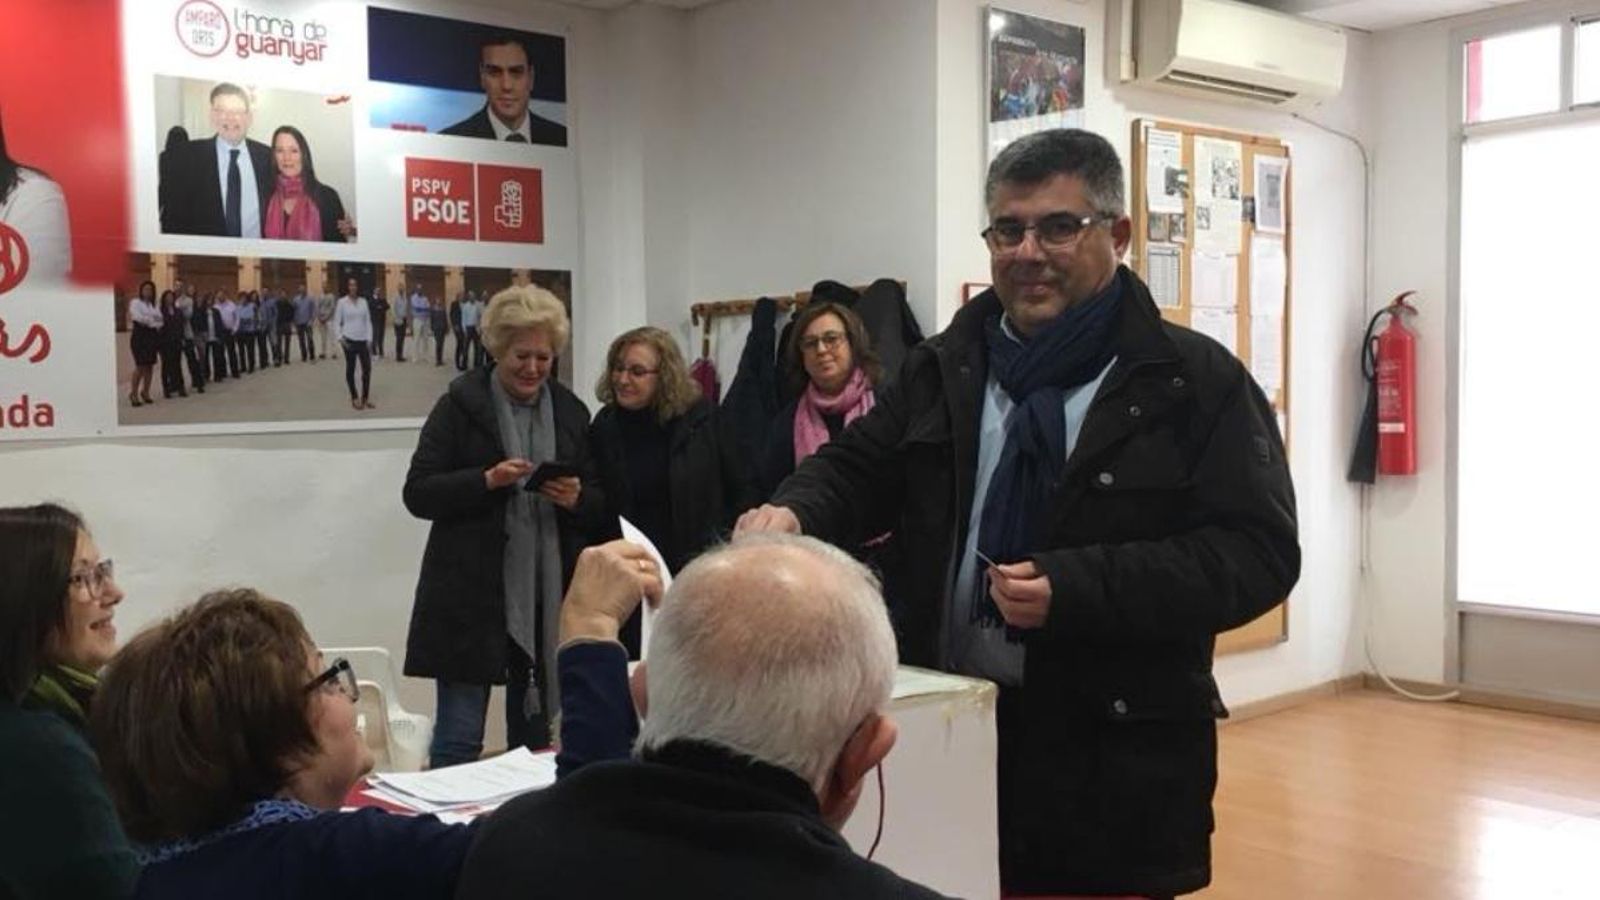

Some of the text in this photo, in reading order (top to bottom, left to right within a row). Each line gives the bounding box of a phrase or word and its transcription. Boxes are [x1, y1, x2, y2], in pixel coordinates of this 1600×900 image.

[303, 20, 328, 41] de
[234, 32, 328, 66] guanyar
[411, 177, 451, 195] PSPV
[412, 197, 471, 225] PSOE
[0, 394, 55, 428] da
